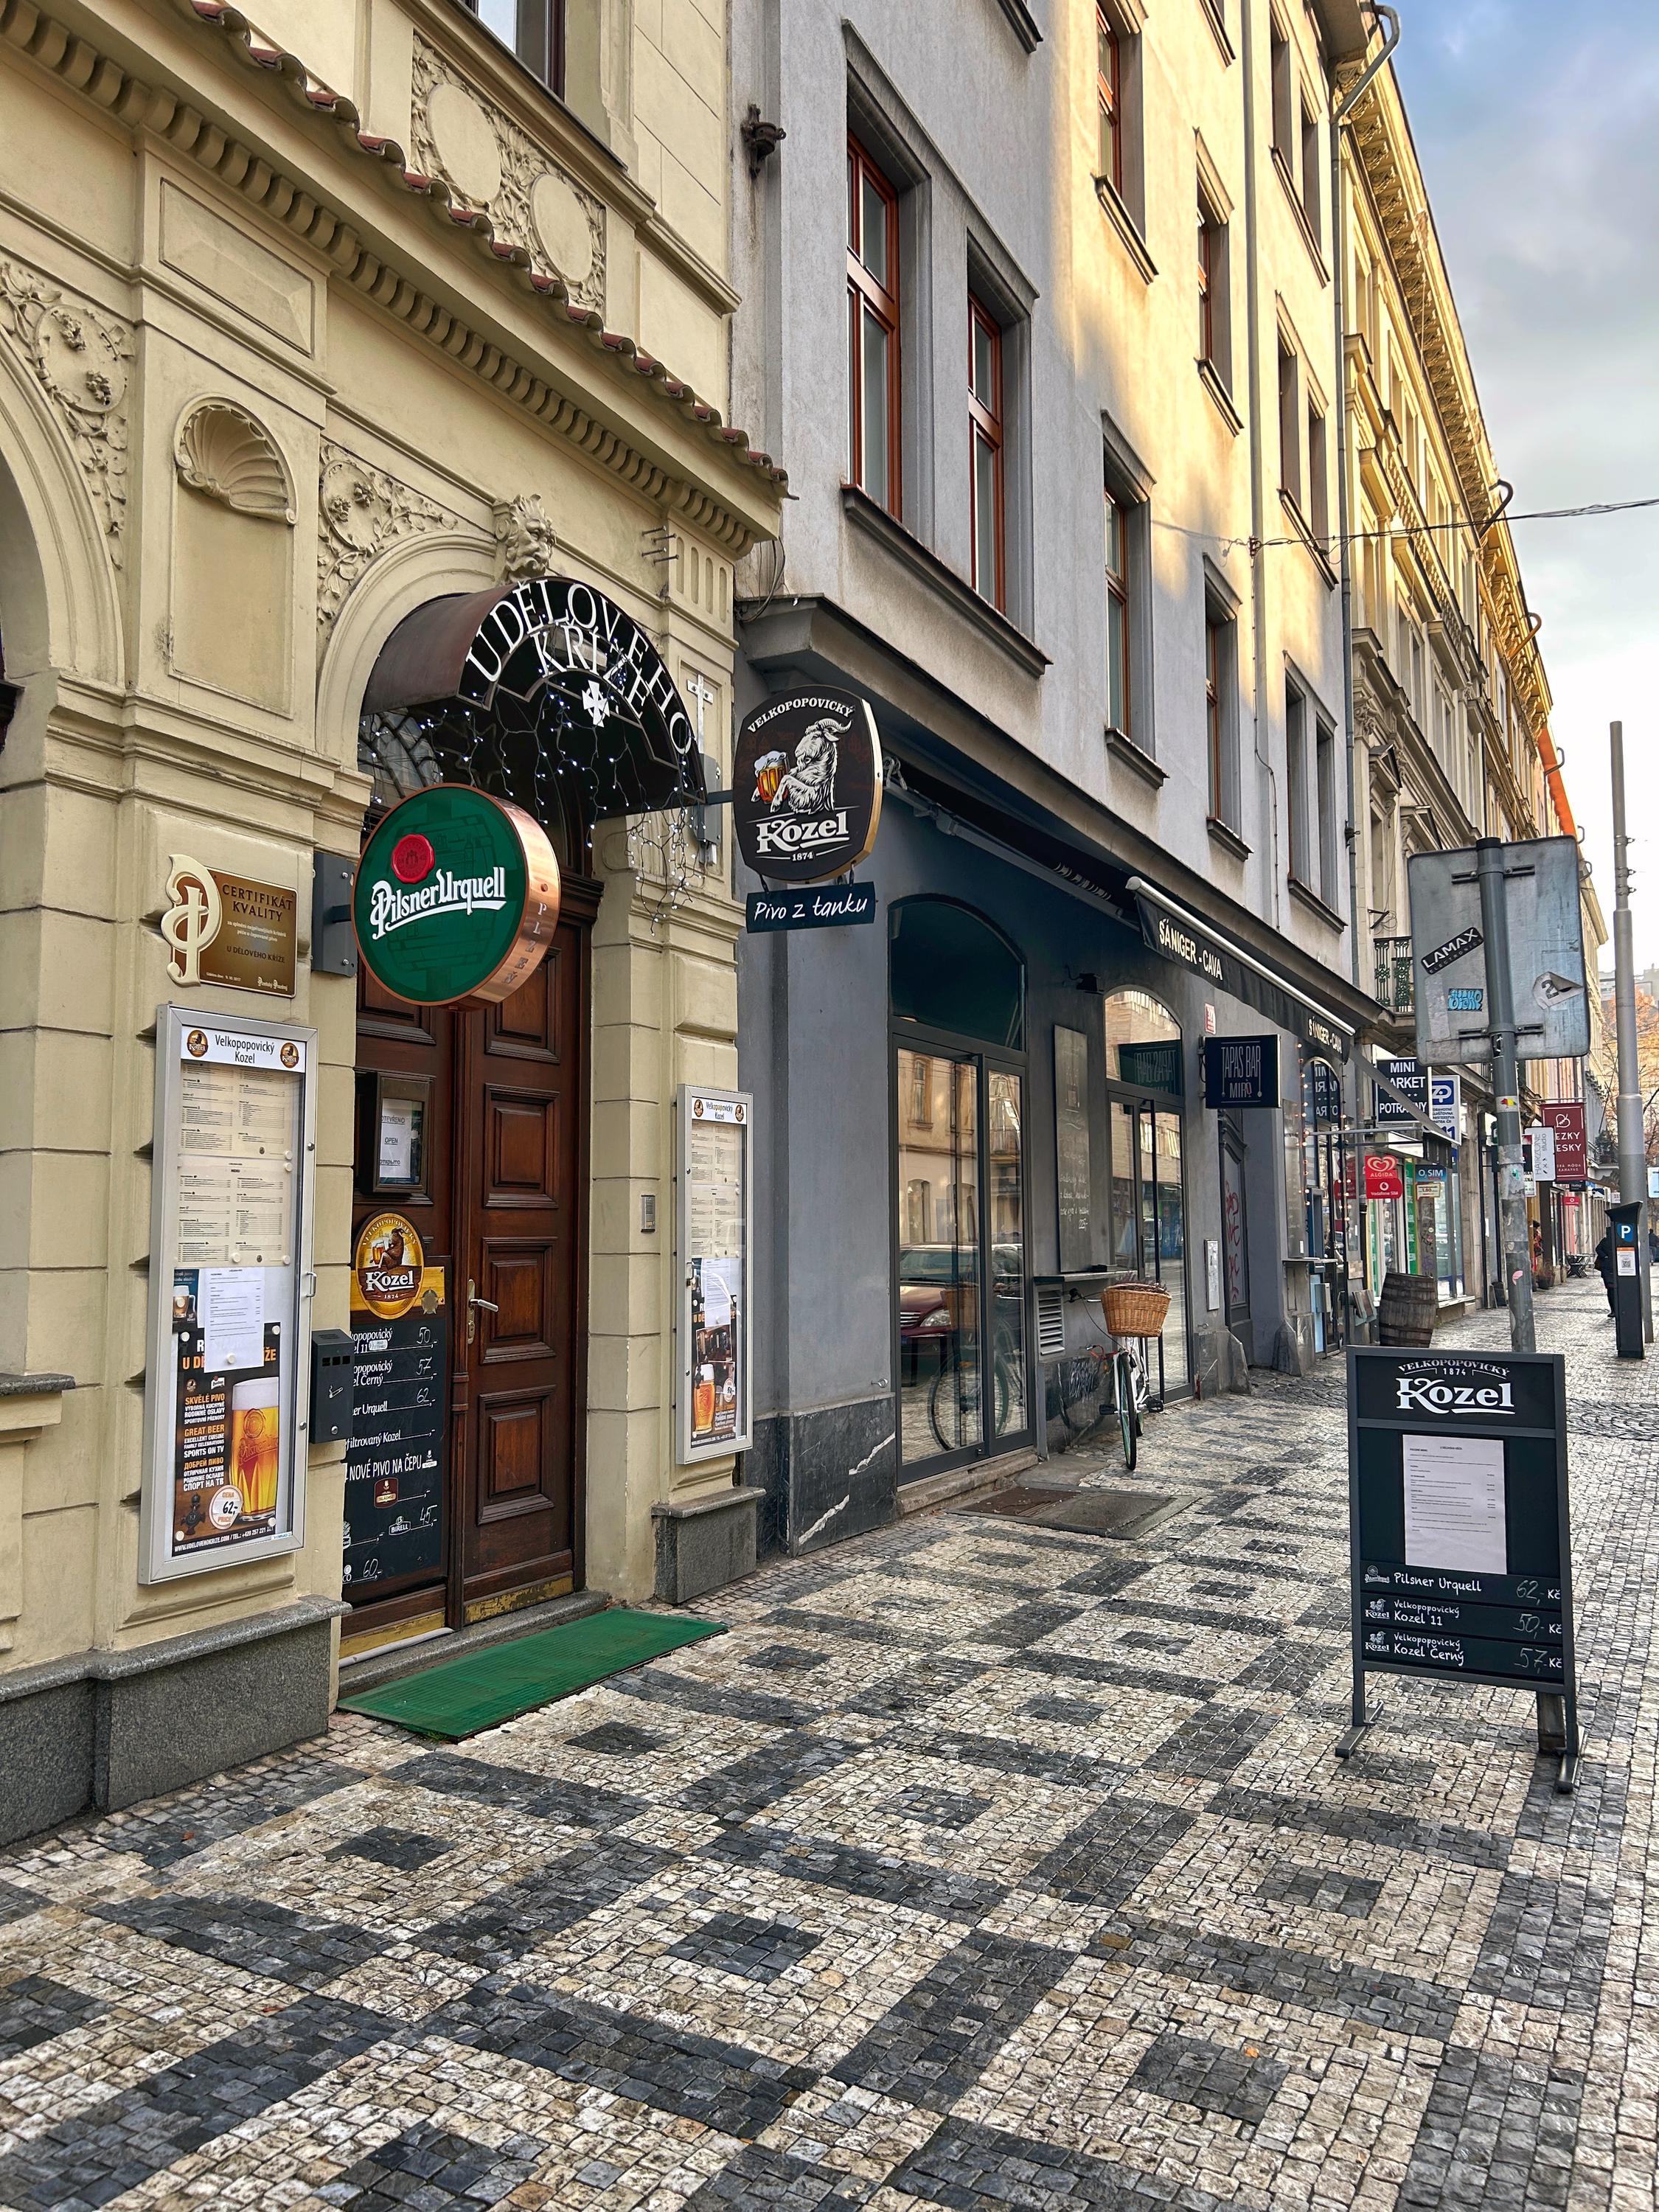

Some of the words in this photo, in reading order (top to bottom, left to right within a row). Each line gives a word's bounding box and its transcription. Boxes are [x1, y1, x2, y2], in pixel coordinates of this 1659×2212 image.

[747, 698, 855, 734] VELKOPOPOVICKÝ
[757, 810, 849, 854] Kozel
[792, 852, 813, 861] 1874
[222, 884, 293, 911] CERTIFIKÁT
[369, 880, 439, 940] Pilsner
[436, 866, 507, 916] Urquell
[233, 900, 283, 922] KVALITY
[754, 901, 787, 921] Pivo
[791, 903, 806, 919] z
[813, 892, 868, 917] tanku
[1422, 928, 1478, 968] LAMAX
[1203, 949, 1223, 981] CAVA
[215, 1034, 275, 1055] Velkopopovický
[234, 1051, 255, 1064] Kozel
[1221, 1046, 1244, 1078] TAPAS
[1245, 1046, 1261, 1078] BAR
[1390, 1062, 1415, 1074] MINI
[1556, 1132, 1580, 1141] EZKY
[1556, 1144, 1582, 1152] ESKY
[1427, 1169, 1444, 1178] SIM
[1621, 1225, 1631, 1239] P
[366, 1270, 414, 1292] Kozel
[361, 1343, 368, 1354] 11
[1398, 1359, 1510, 1377] VELKOPOPOVICKÝ
[1443, 1368, 1466, 1376] 1874
[361, 1371, 383, 1387] Černý
[185, 1394, 210, 1405] SKVĚLÉ
[211, 1393, 226, 1402] PIVO
[1396, 1377, 1516, 1415] Kozel
[362, 1400, 388, 1416] Urquell
[184, 1427, 206, 1437] GREAT
[207, 1424, 225, 1434] BEER
[383, 1429, 401, 1443] Kozel
[184, 1447, 206, 1458] SPORTS
[207, 1446, 216, 1455] ON
[217, 1445, 225, 1453] TV
[349, 1458, 371, 1481] NOVÉ
[372, 1460, 390, 1478] PIVO
[392, 1458, 403, 1474] NA
[404, 1453, 422, 1472] ČEPU
[183, 1481, 205, 1492] СПОРТ
[205, 1479, 215, 1489] НА
[215, 1478, 224, 1486] ТВ
[223, 1501, 238, 1515] 62,-
[391, 1523, 408, 1533] BIRELL
[1394, 1572, 1434, 1587] Pilsner
[1439, 1577, 1482, 1596] Urquell
[1547, 1589, 1561, 1600] Kč
[1365, 1609, 1390, 1620] Kozel
[1394, 1599, 1460, 1618] Velkopopovický
[1394, 1610, 1426, 1625] Kozel
[1430, 1615, 1443, 1626] 11
[1548, 1624, 1562, 1635] Kč
[1365, 1641, 1390, 1652] Kozel
[1394, 1632, 1461, 1652] Velkopopovický
[1394, 1643, 1426, 1658] Kozel
[1430, 1644, 1464, 1666] Černý
[1548, 1658, 1562, 1669] Kč
